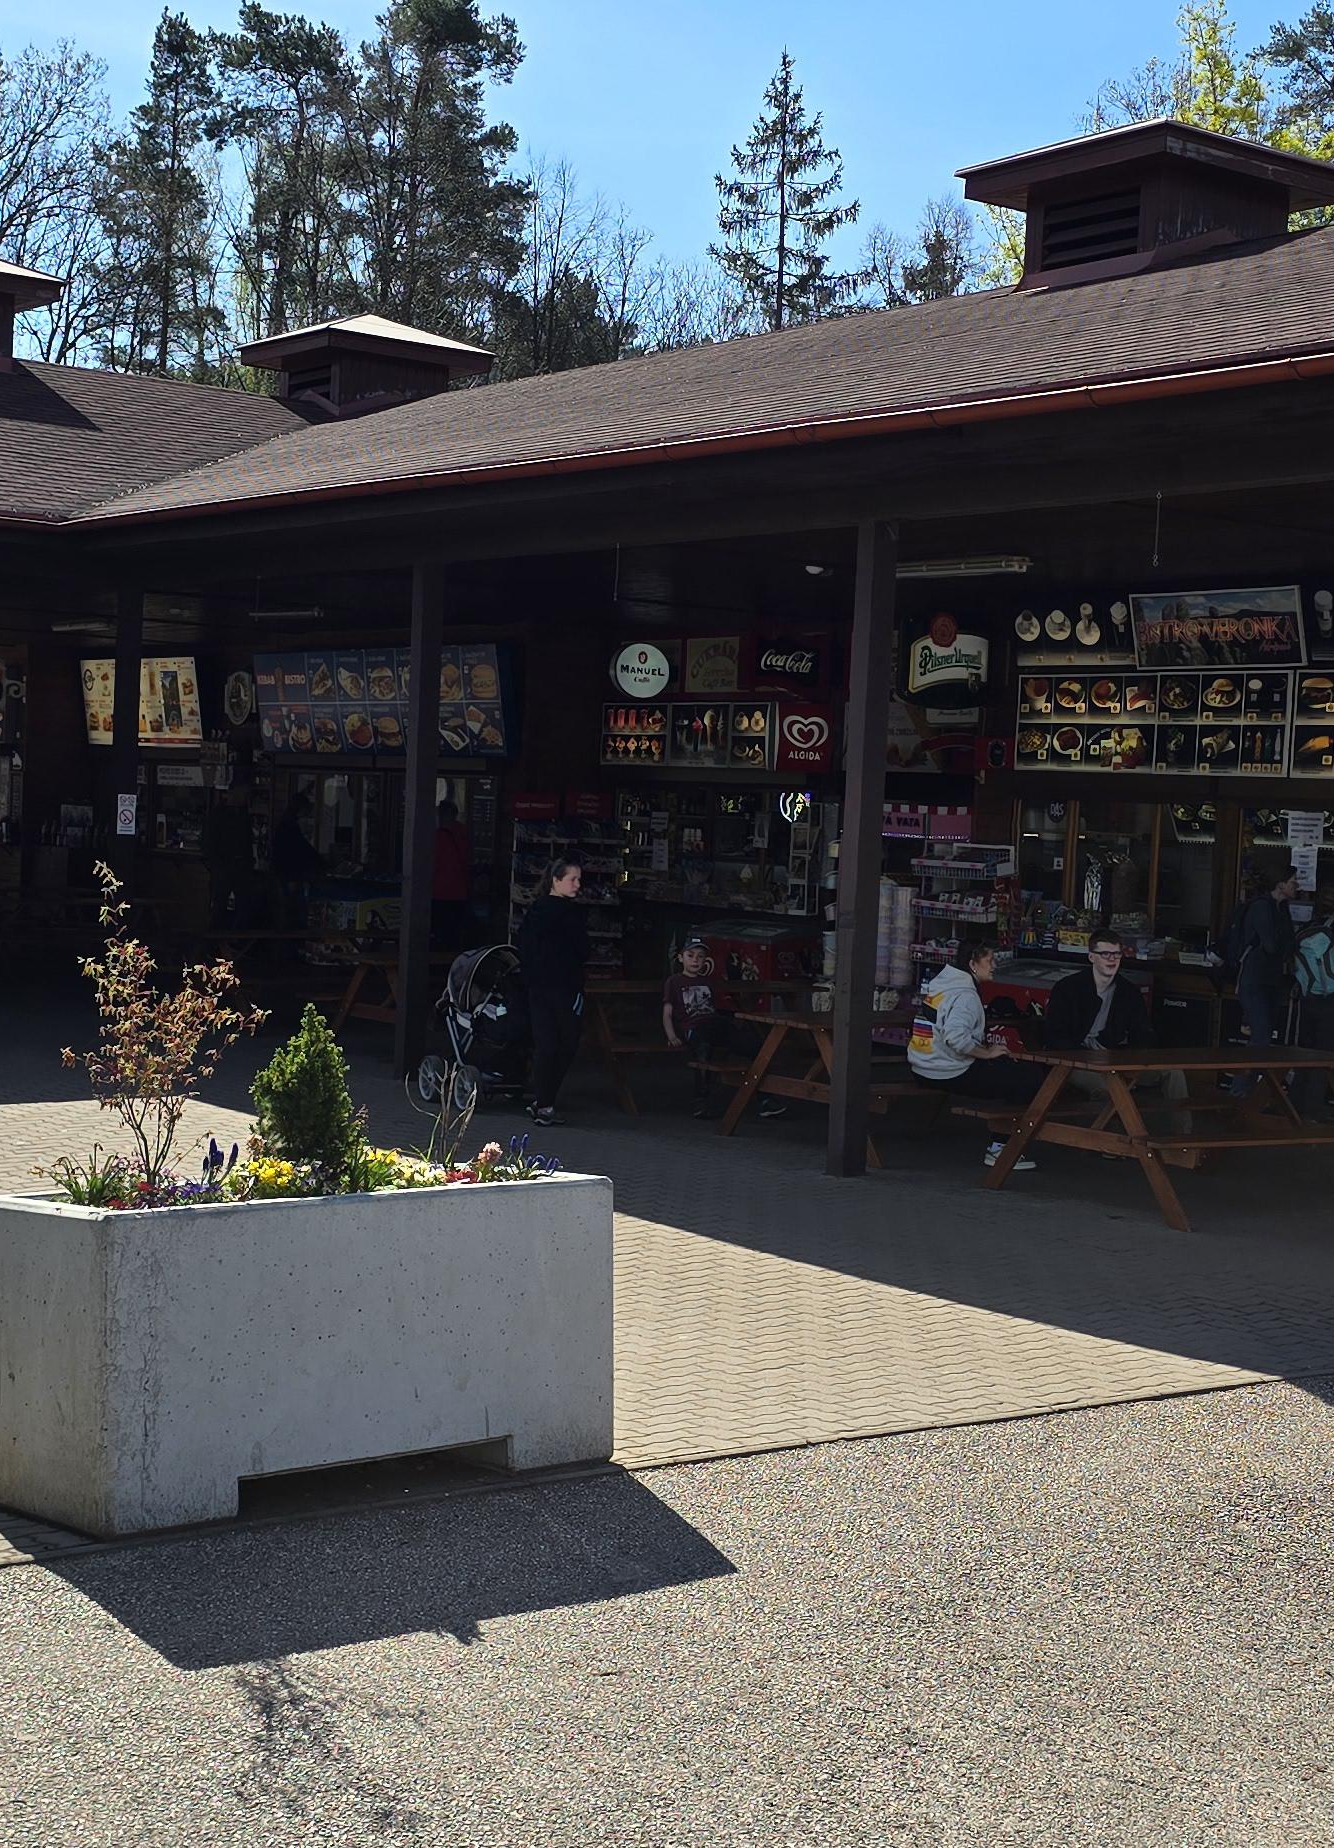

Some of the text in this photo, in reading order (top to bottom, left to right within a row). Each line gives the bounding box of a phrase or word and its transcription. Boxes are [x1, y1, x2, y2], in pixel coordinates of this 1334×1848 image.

[919, 645, 982, 676] Pilsner Urquell
[620, 664, 665, 677] MANUEL
[788, 750, 821, 761] ALGIDA
[896, 817, 920, 828] VATA
[986, 1033, 1007, 1045] GIDA
